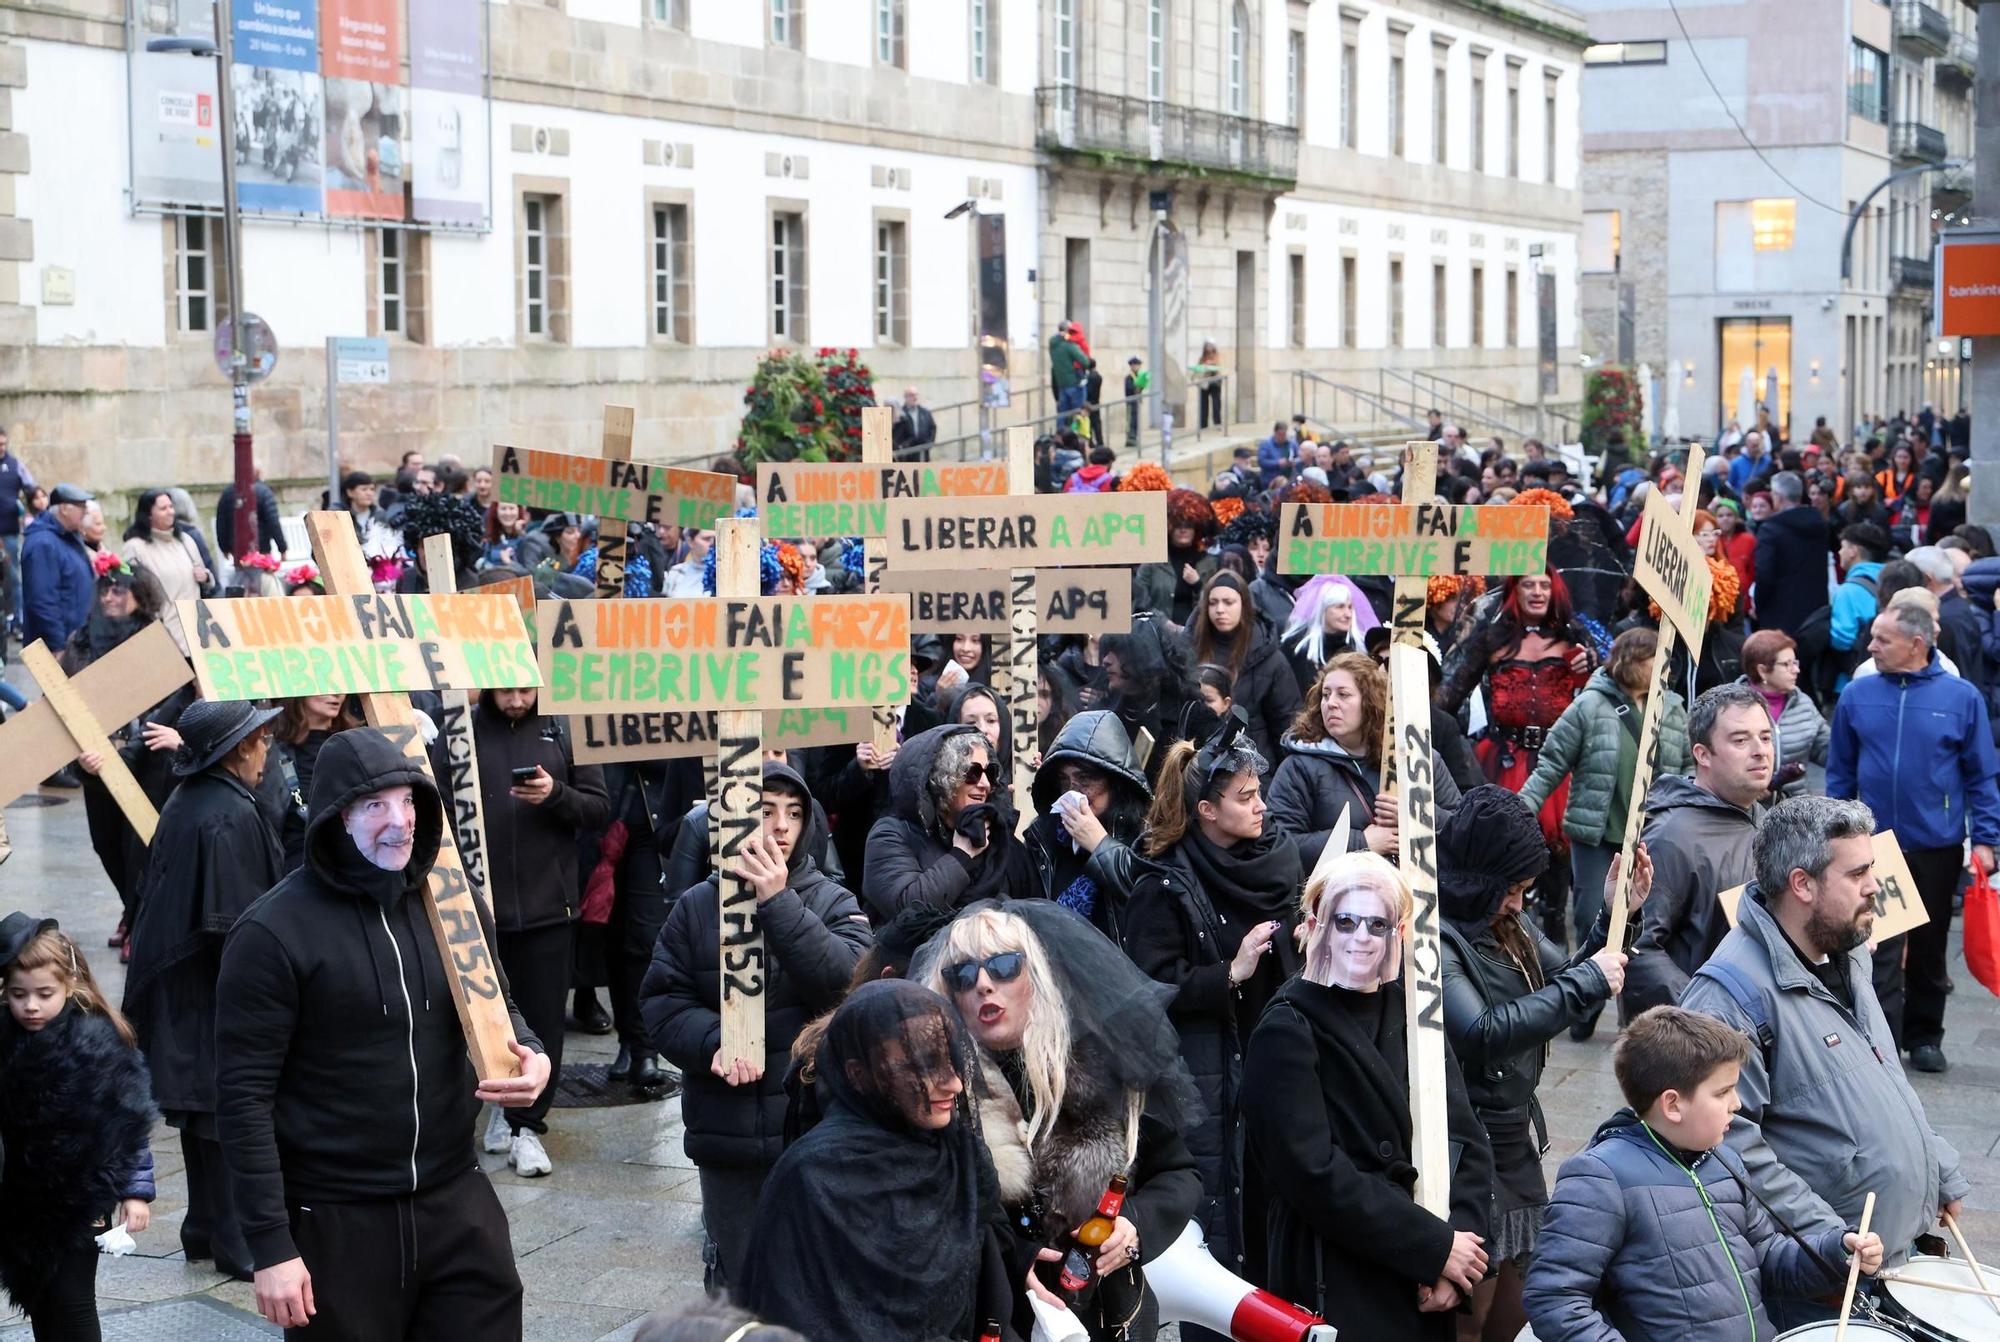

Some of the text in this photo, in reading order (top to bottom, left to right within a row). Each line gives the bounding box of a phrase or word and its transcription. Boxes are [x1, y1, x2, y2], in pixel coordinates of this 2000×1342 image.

[501, 446, 520, 474] A
[528, 450, 605, 485] UNION
[767, 472, 787, 503] A
[795, 470, 876, 503] UNION
[499, 476, 632, 520] BEMBRIVE
[646, 495, 662, 523] E
[1292, 504, 1313, 537] A
[1322, 505, 1410, 537] UNION
[902, 515, 1038, 551] LIBERAR
[1050, 515, 1071, 548] A
[1288, 540, 1547, 576] BEMBRIVE E MOS
[1645, 518, 1689, 606] LIBERAR
[196, 599, 231, 649] A
[232, 596, 360, 647] UNION
[552, 601, 583, 648] A
[596, 602, 717, 648] UNION
[205, 641, 541, 701] BEMBRIVE E MOS
[552, 652, 908, 702] BEMBRIVE E MOS
